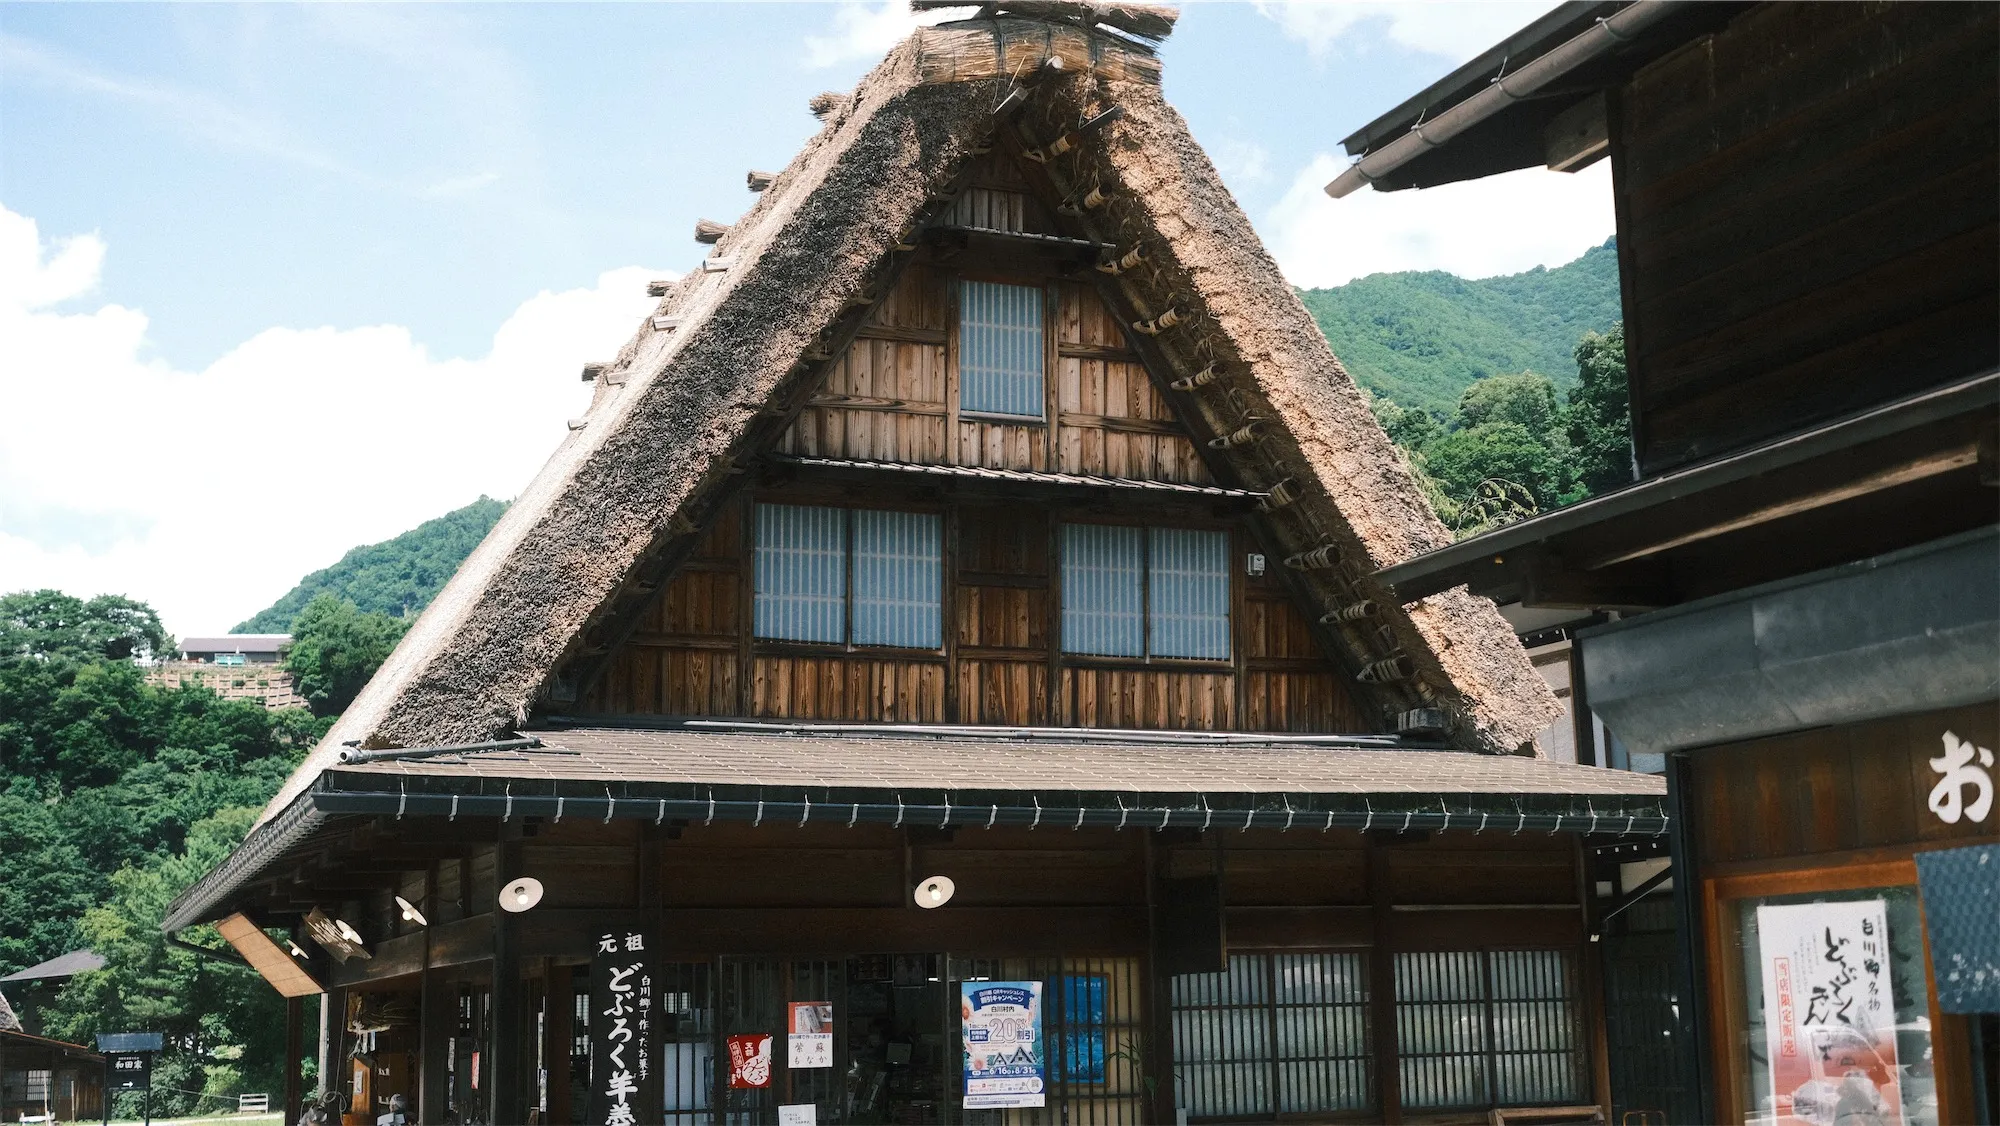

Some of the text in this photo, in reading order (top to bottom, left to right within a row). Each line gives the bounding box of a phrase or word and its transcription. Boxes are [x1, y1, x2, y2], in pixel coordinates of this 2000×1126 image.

[1928, 729, 1995, 824] お
[599, 932, 645, 953] 元祖
[638, 975, 651, 1080] 白川郷で作ったお菓子
[1779, 963, 1794, 1053] 当店限定販売
[115, 1060, 143, 1069] 和田家
[795, 1056, 828, 1065] もなか
